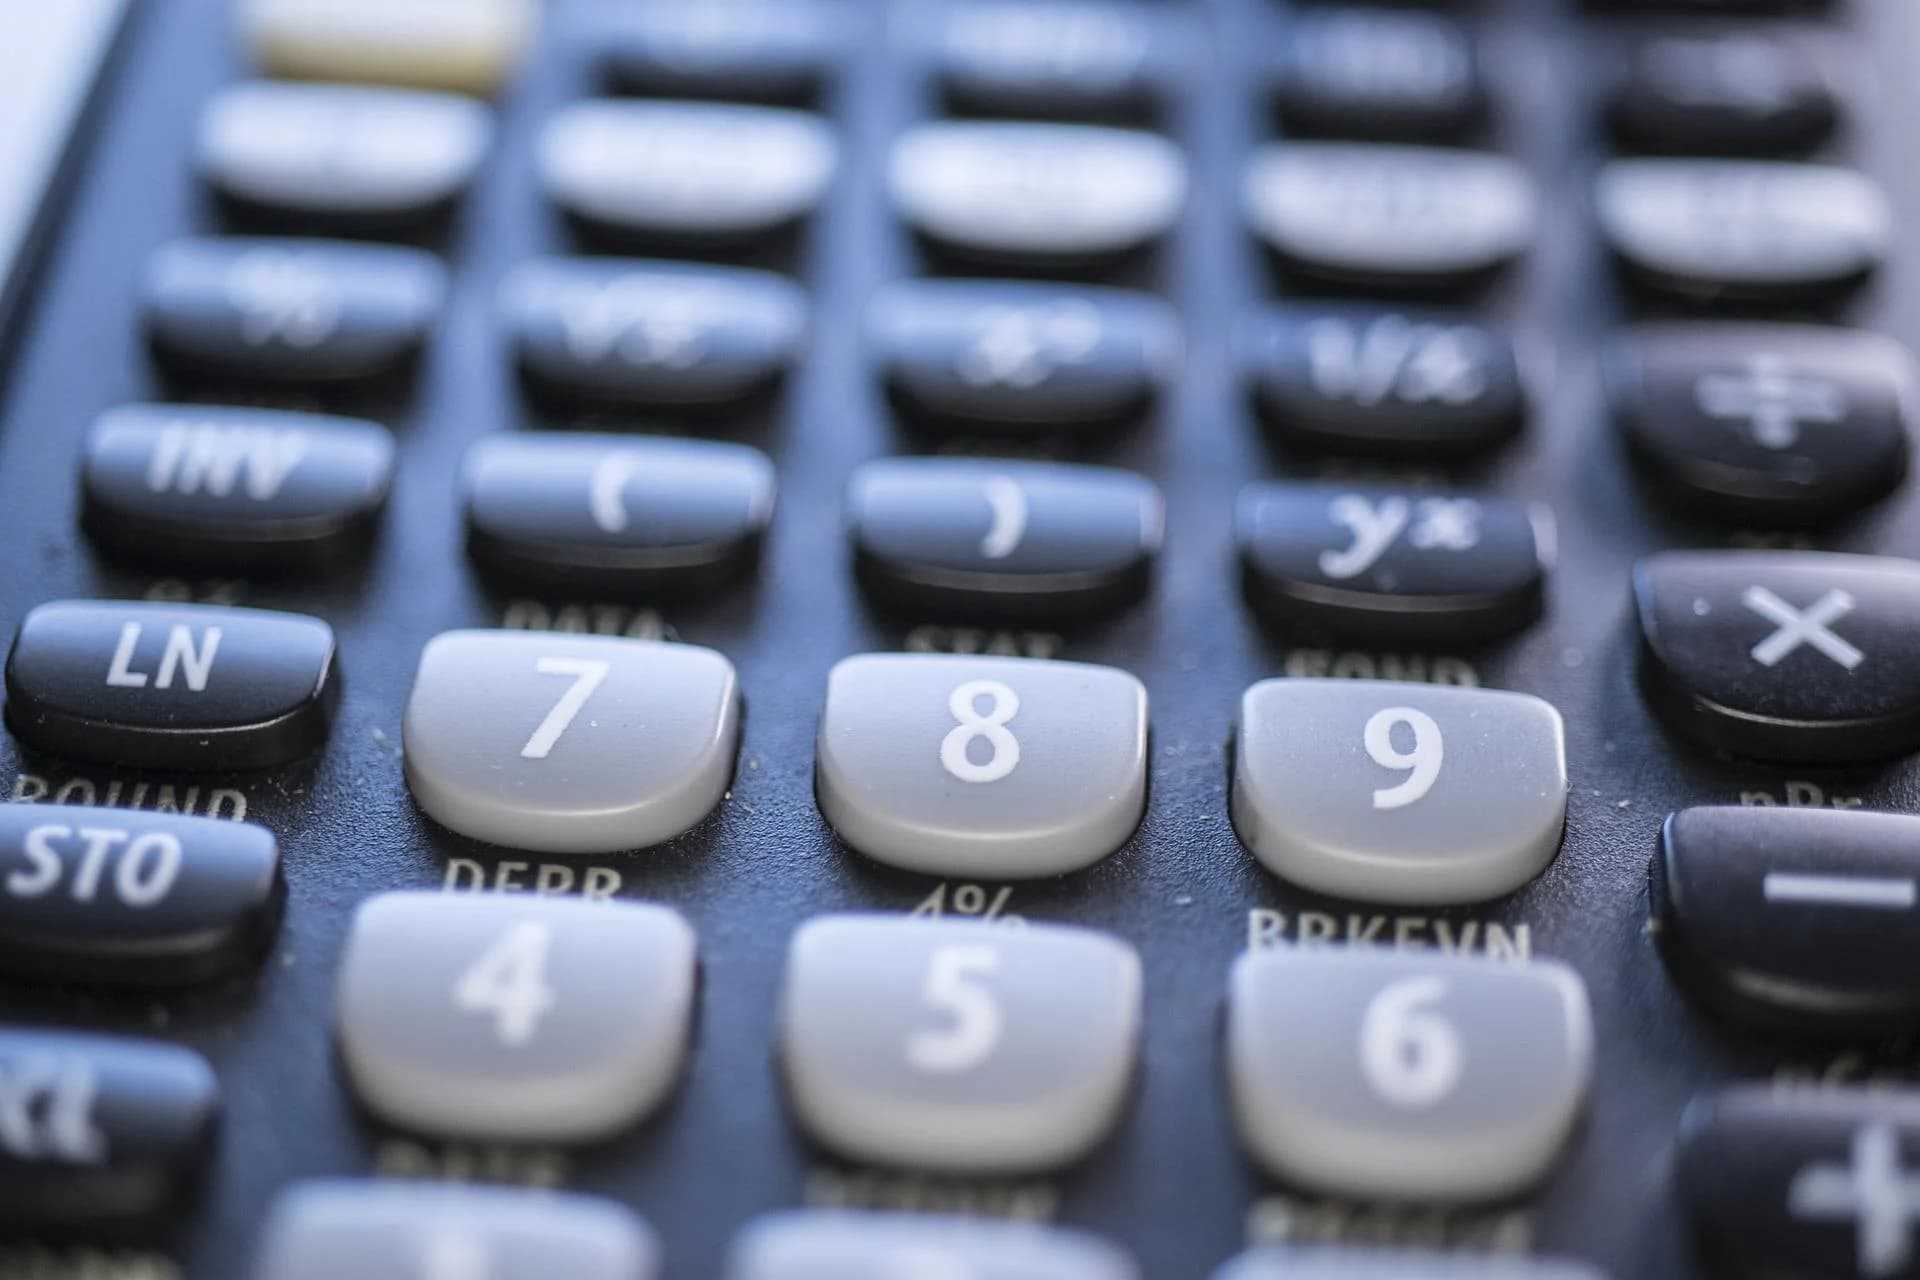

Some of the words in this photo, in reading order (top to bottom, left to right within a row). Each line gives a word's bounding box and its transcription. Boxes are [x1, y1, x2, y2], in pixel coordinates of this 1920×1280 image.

[106, 622, 222, 692] LN
[520, 657, 610, 759] 7
[941, 680, 1020, 783] 8
[1363, 706, 1444, 810] 9
[5, 824, 183, 908] STO
[454, 921, 554, 1045] 4
[904, 944, 1003, 1073] 5
[1359, 976, 1464, 1107] 6
